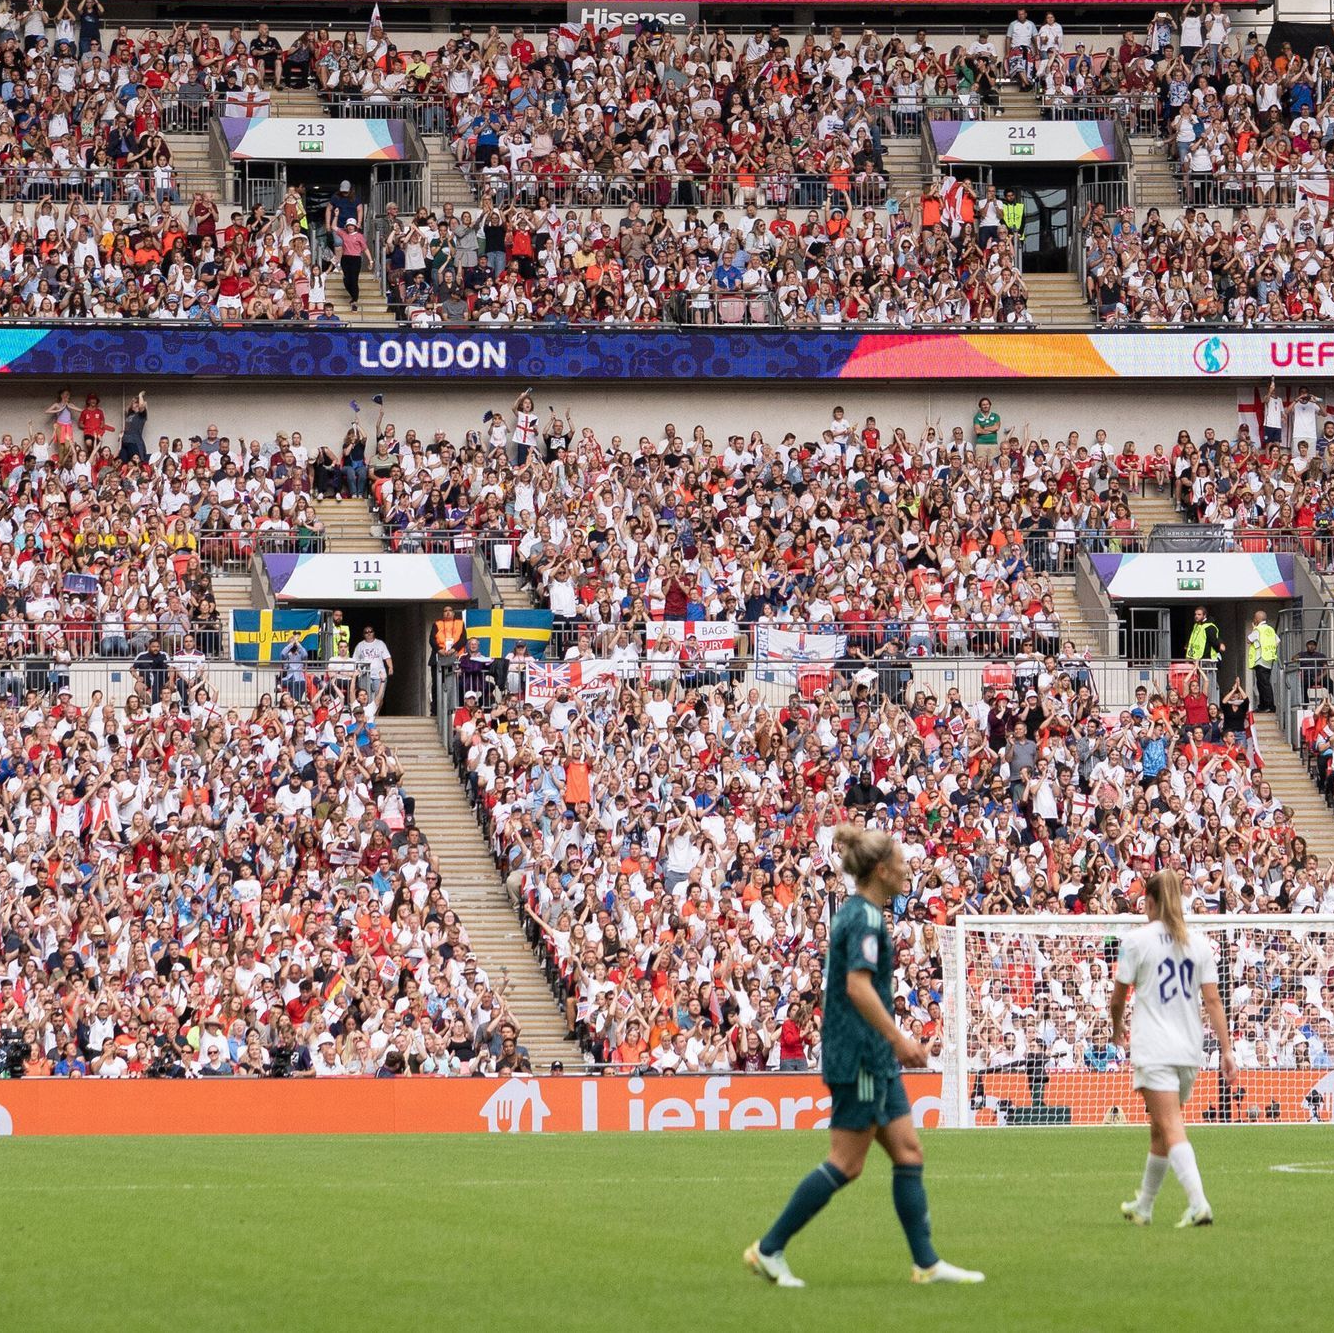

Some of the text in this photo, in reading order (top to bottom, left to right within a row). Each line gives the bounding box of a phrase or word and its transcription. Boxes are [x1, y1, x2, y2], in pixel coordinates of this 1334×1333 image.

[581, 8, 686, 25] Hisense
[297, 123, 325, 136] 213
[1008, 127, 1037, 139] 214
[359, 341, 507, 369] LONDON
[353, 560, 382, 574] 111
[1176, 560, 1206, 573] 112
[248, 632, 266, 643] LIU
[654, 626, 728, 636] OD BAGS
[1158, 957, 1195, 1004] 20
